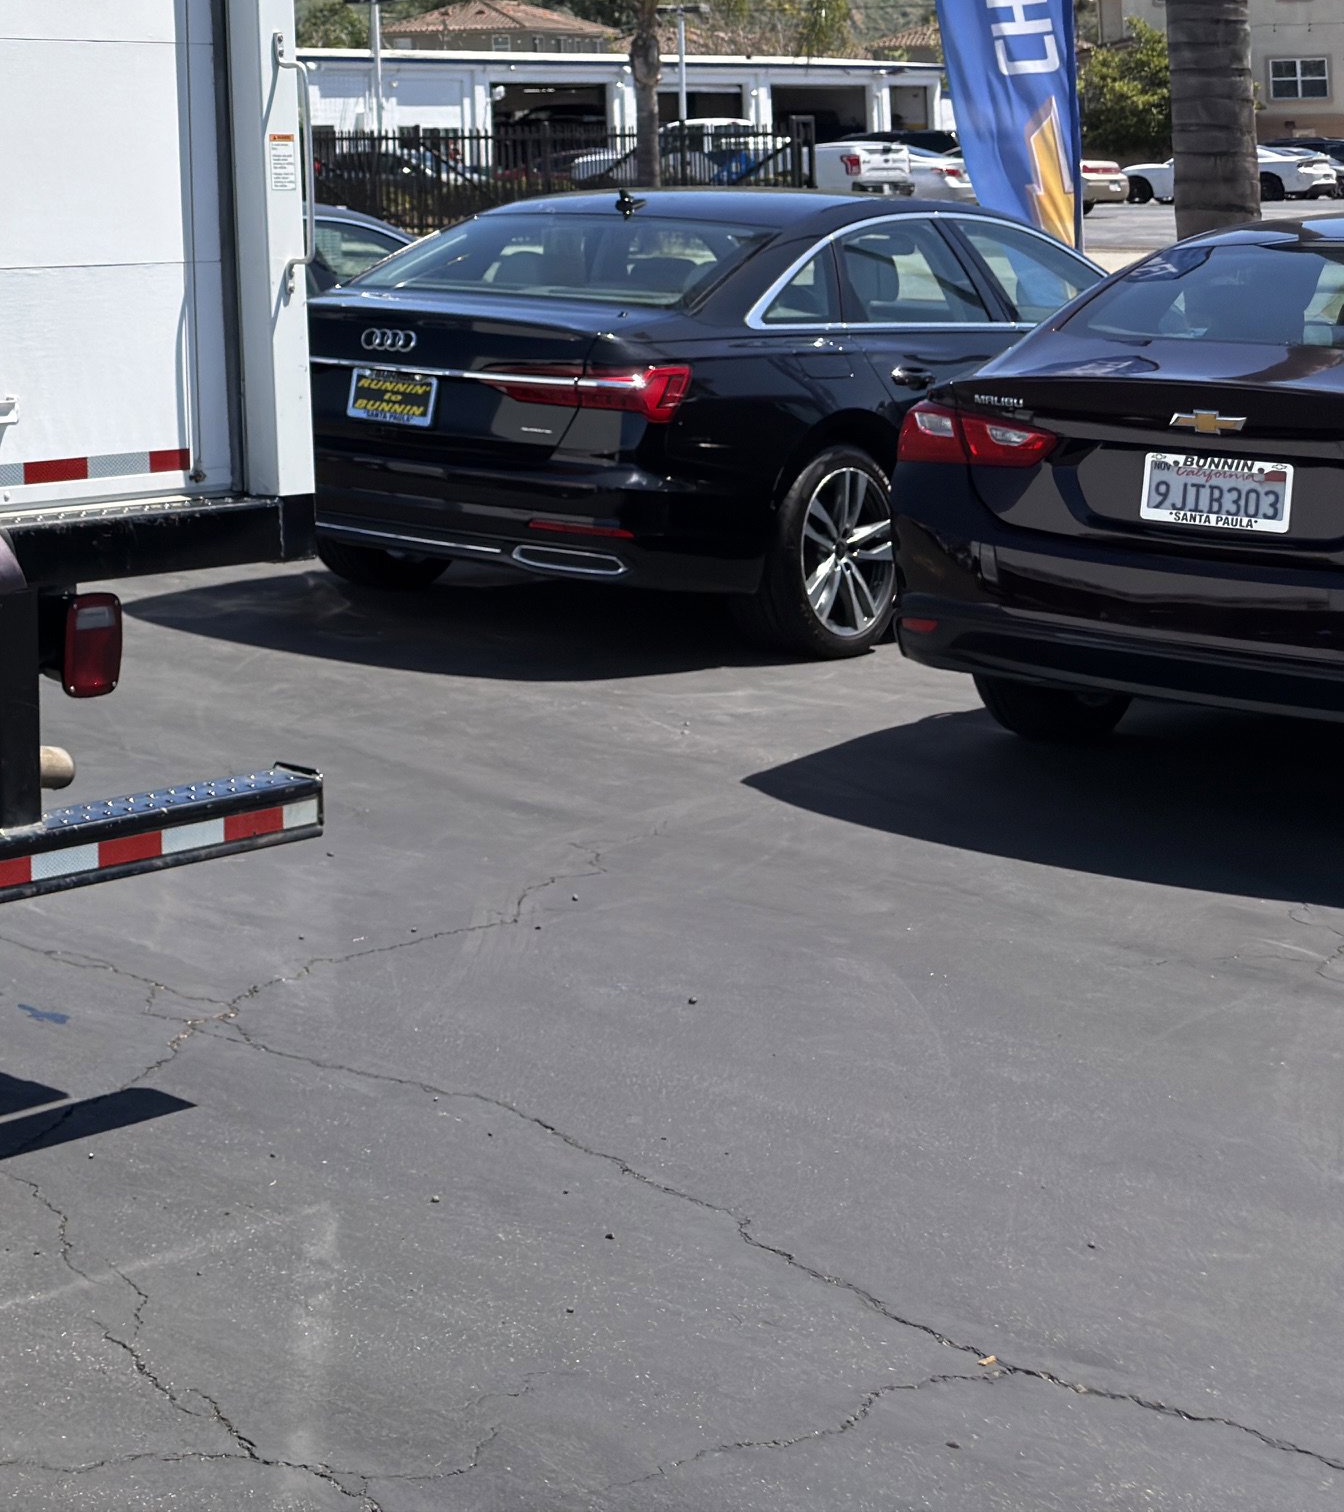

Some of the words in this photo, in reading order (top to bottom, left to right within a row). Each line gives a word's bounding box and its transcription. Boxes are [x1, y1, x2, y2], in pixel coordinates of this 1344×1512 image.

[384, 392, 402, 401] to
[974, 394, 1024, 408] MALIBU
[354, 399, 425, 416] BUNNIN
[1153, 461, 1171, 472] NOV
[1183, 455, 1255, 472] BUNNIN
[1176, 466, 1264, 483] California
